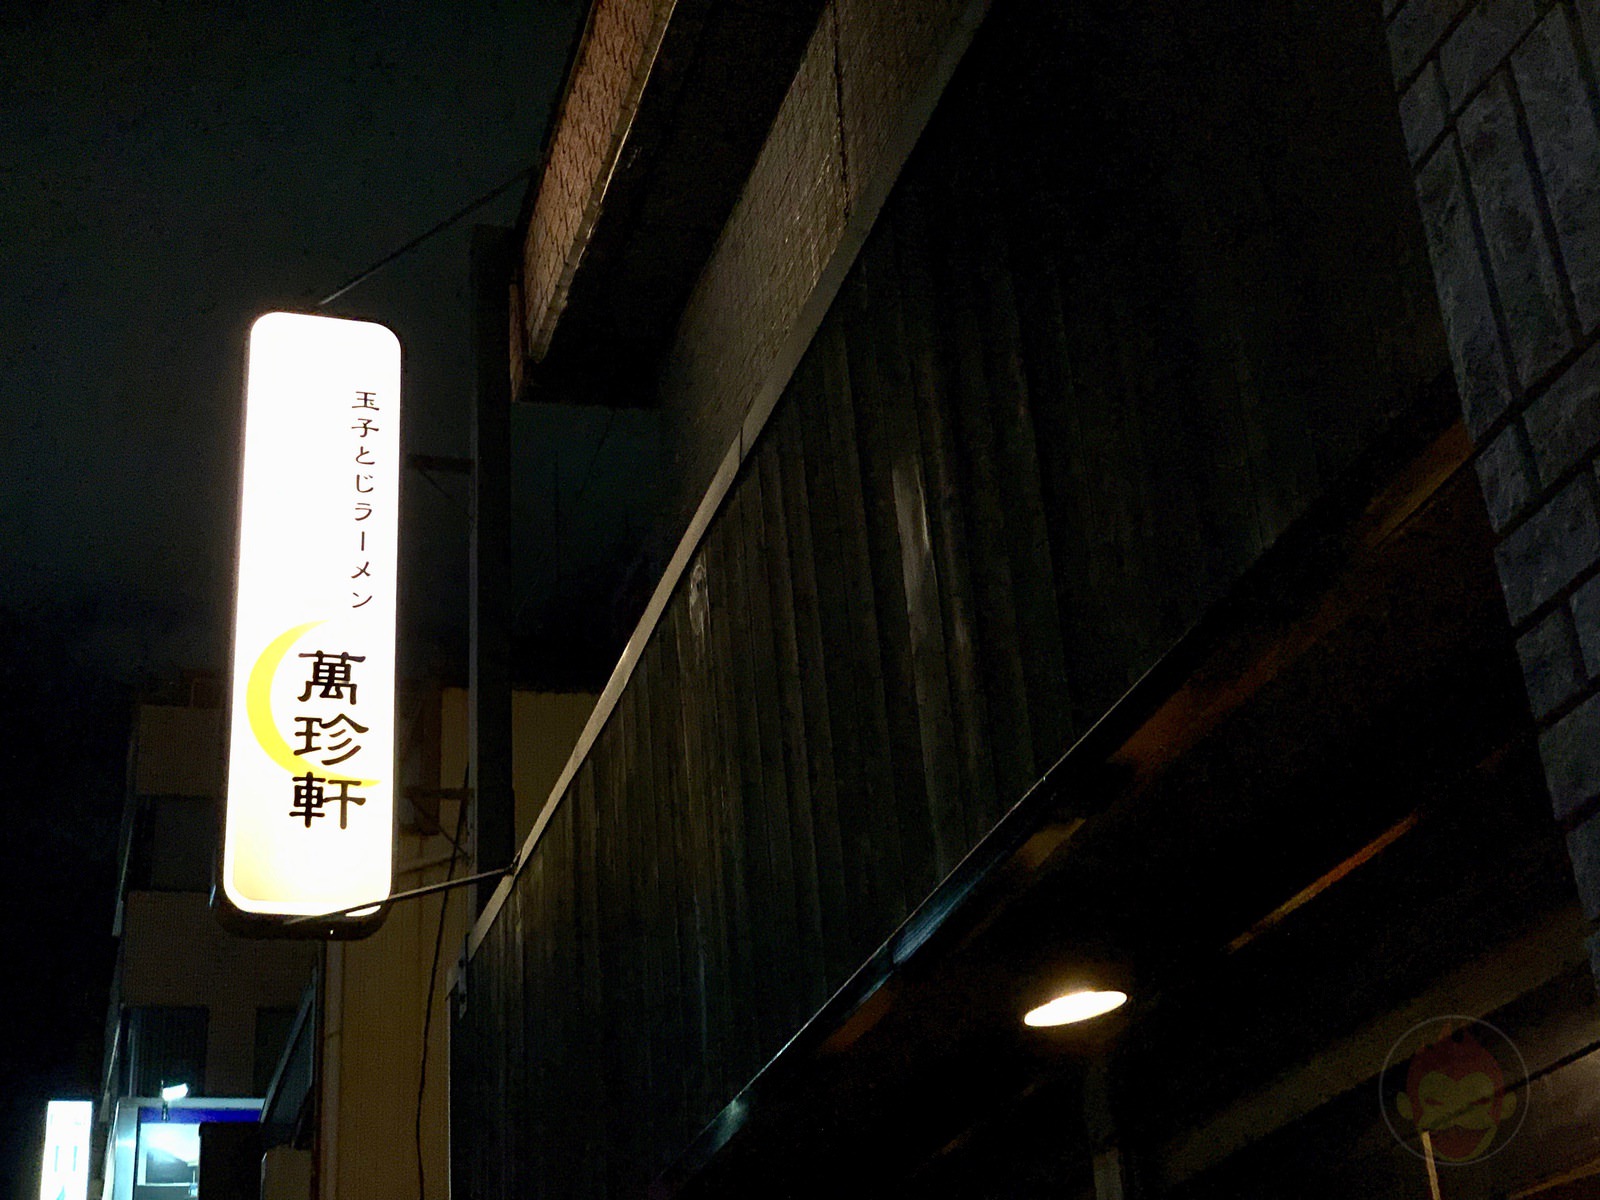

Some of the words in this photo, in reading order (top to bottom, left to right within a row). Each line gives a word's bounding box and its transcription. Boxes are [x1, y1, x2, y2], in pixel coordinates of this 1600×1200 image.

[350, 391, 380, 609] 玉子とじラーメン
[289, 649, 370, 830] 萬珍軒
